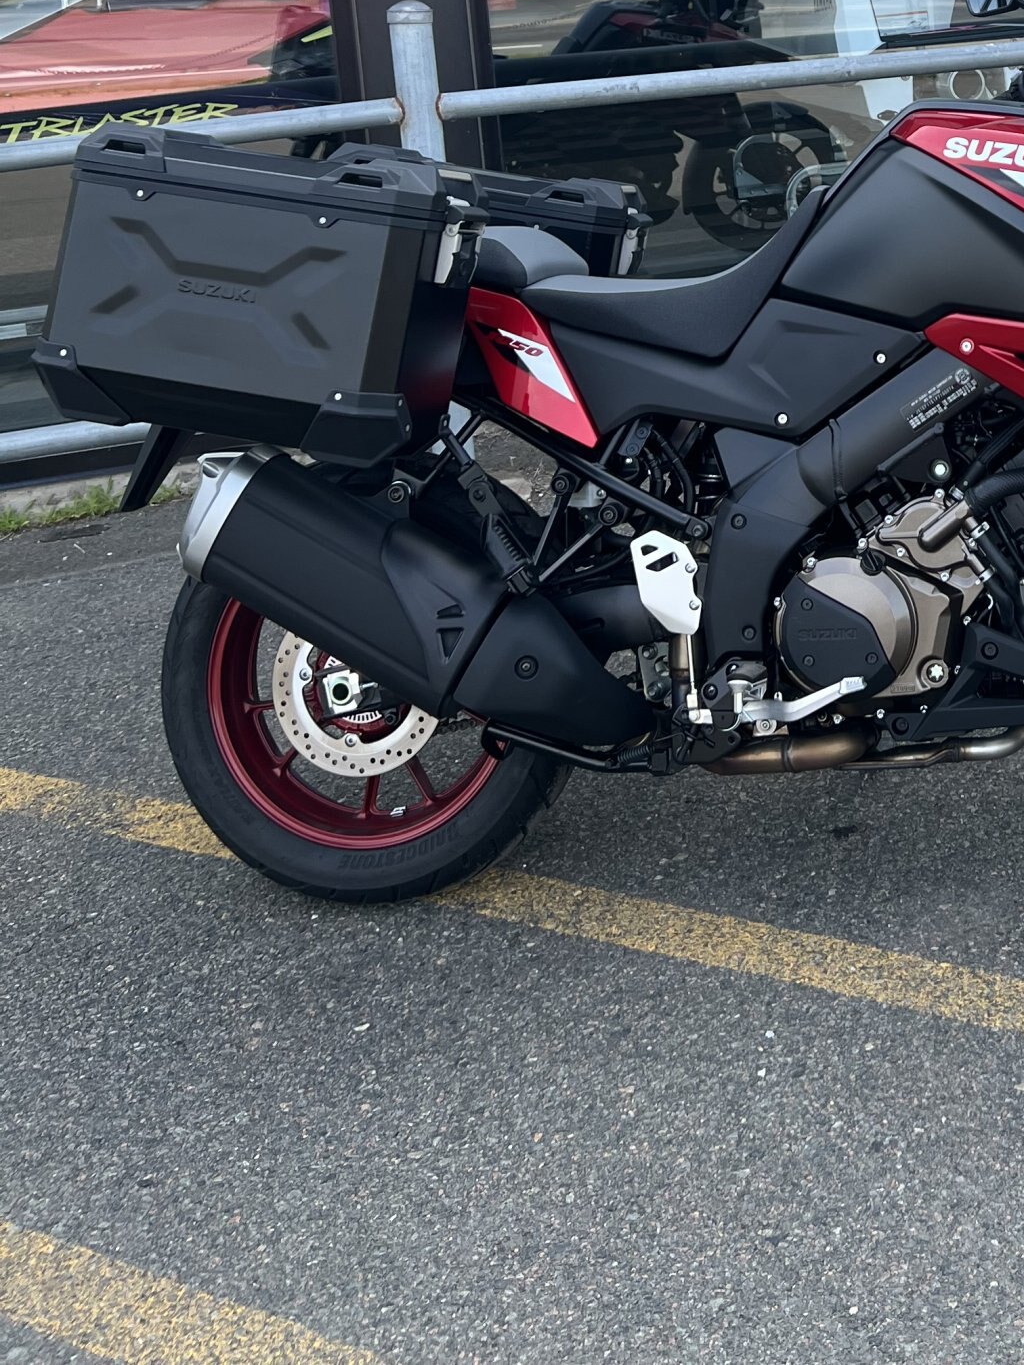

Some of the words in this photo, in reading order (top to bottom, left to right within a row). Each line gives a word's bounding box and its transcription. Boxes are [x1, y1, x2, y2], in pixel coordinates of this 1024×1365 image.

[178, 279, 257, 304] SUZUKI
[797, 627, 858, 642] SUZUKI
[336, 820, 463, 870] BRIDGESTONE
